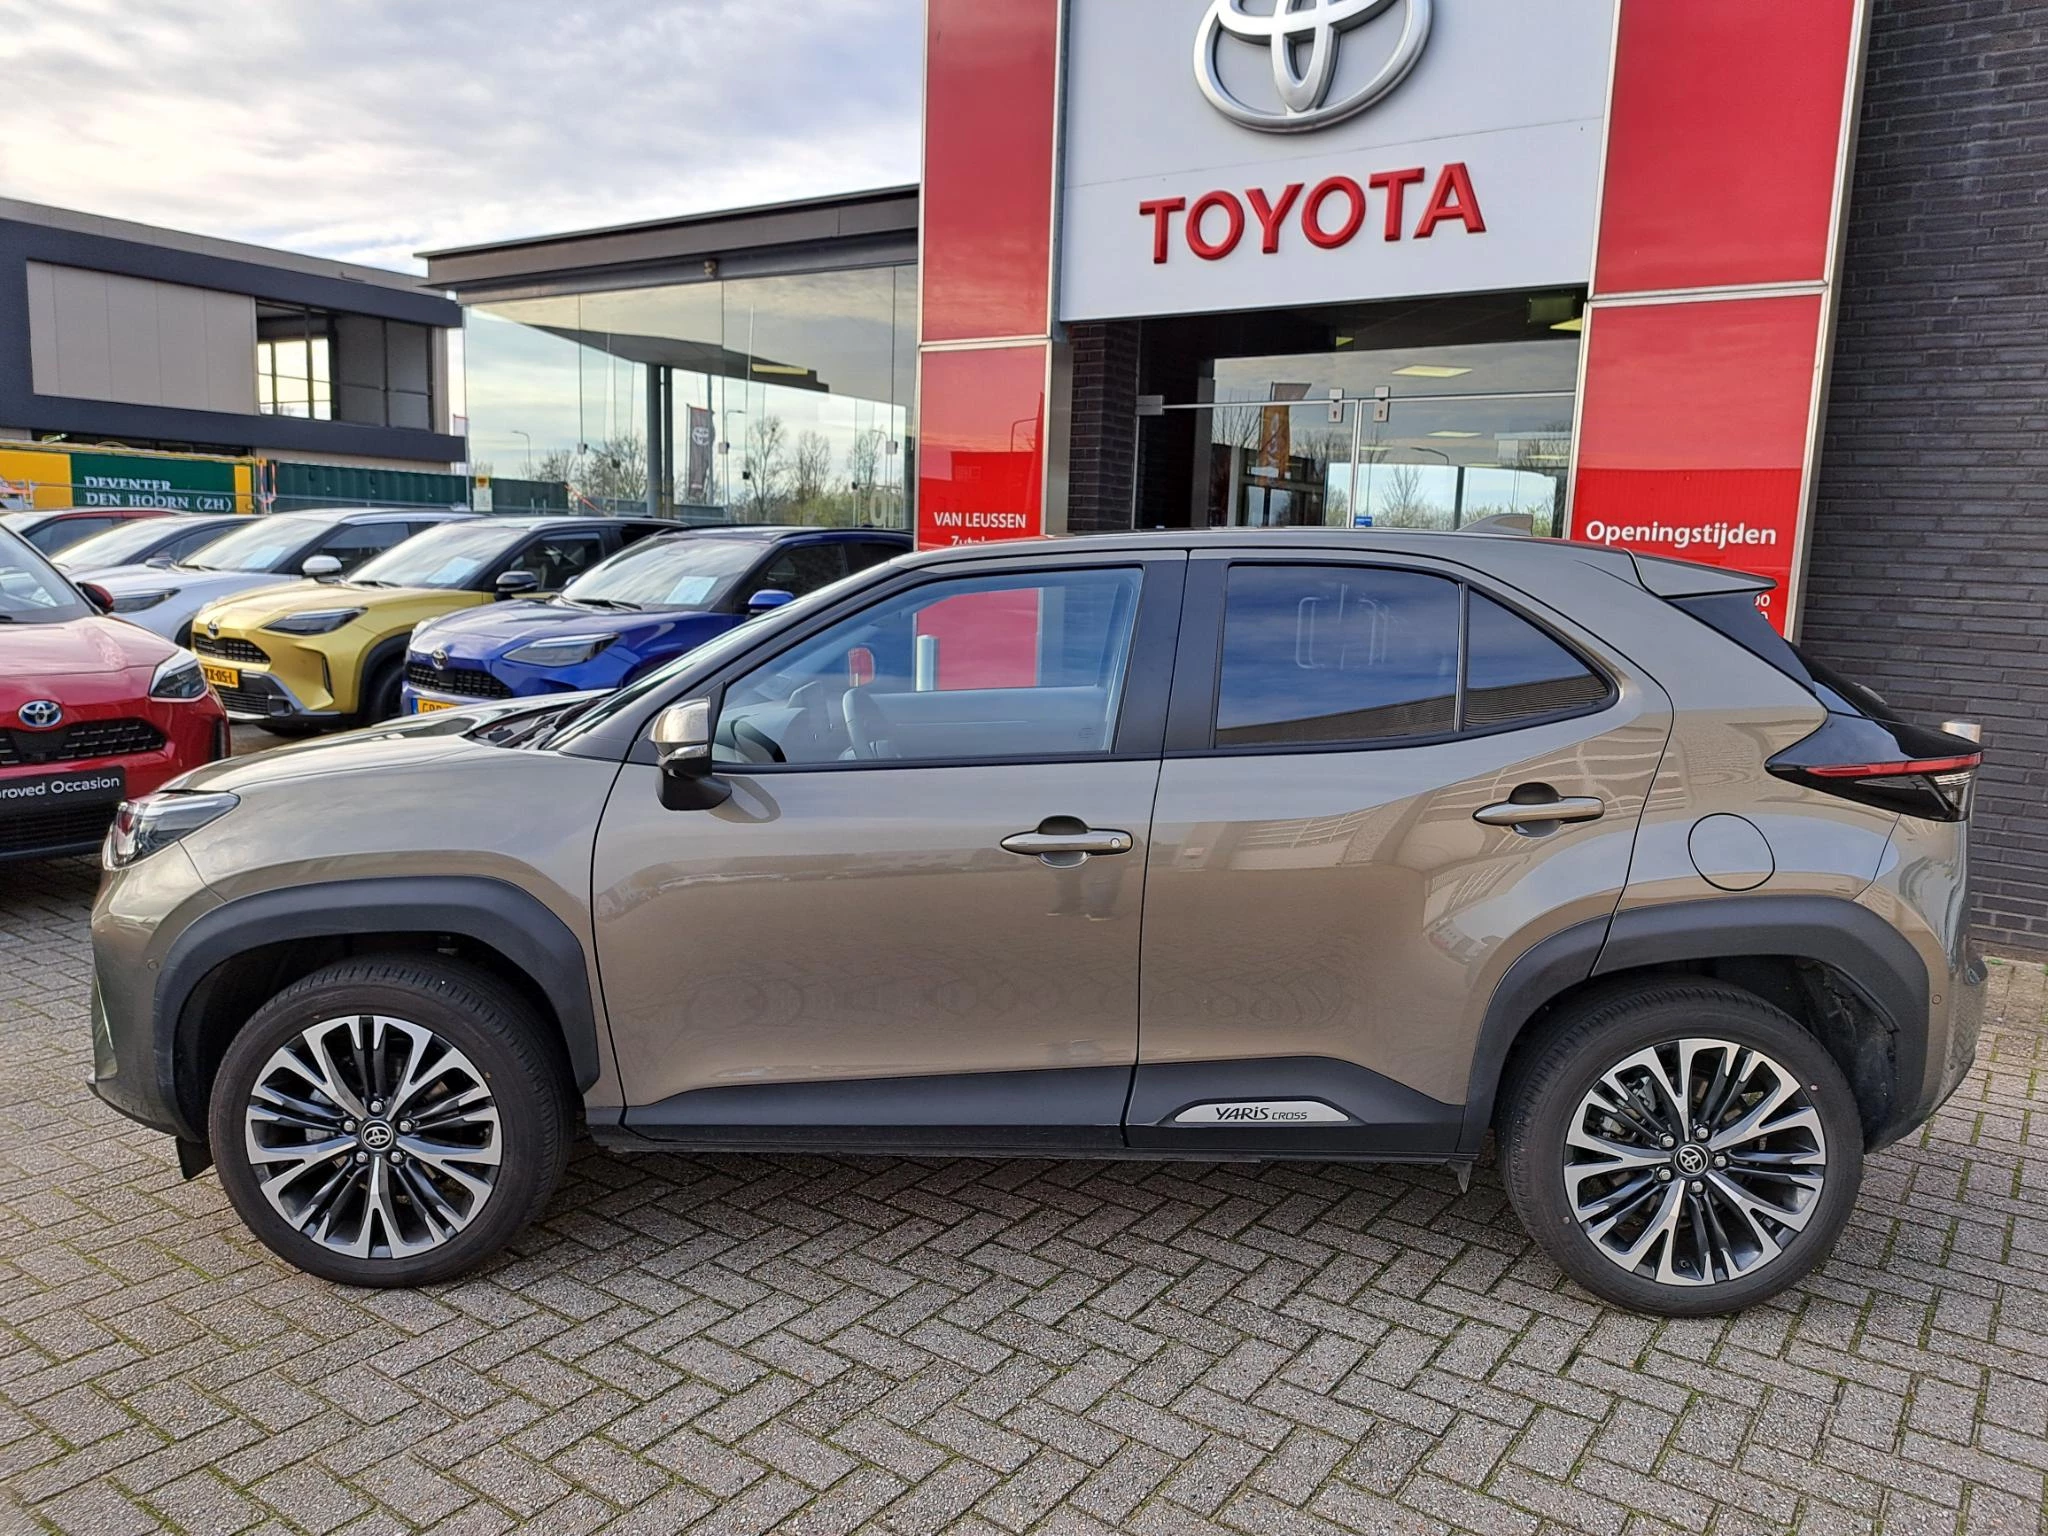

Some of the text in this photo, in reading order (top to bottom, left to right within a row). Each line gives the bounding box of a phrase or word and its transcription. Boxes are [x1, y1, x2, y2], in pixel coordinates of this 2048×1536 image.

[1139, 162, 1486, 264] TOYOTA
[83, 476, 172, 492] DEVENTER
[85, 492, 233, 512] DEN HOORN (ZH)
[933, 511, 1027, 529] VAN LEUSSEN
[1586, 520, 1777, 550] Openingstijden
[0, 776, 120, 799] roved Occasion
[1271, 1111, 1308, 1121] CROSS
